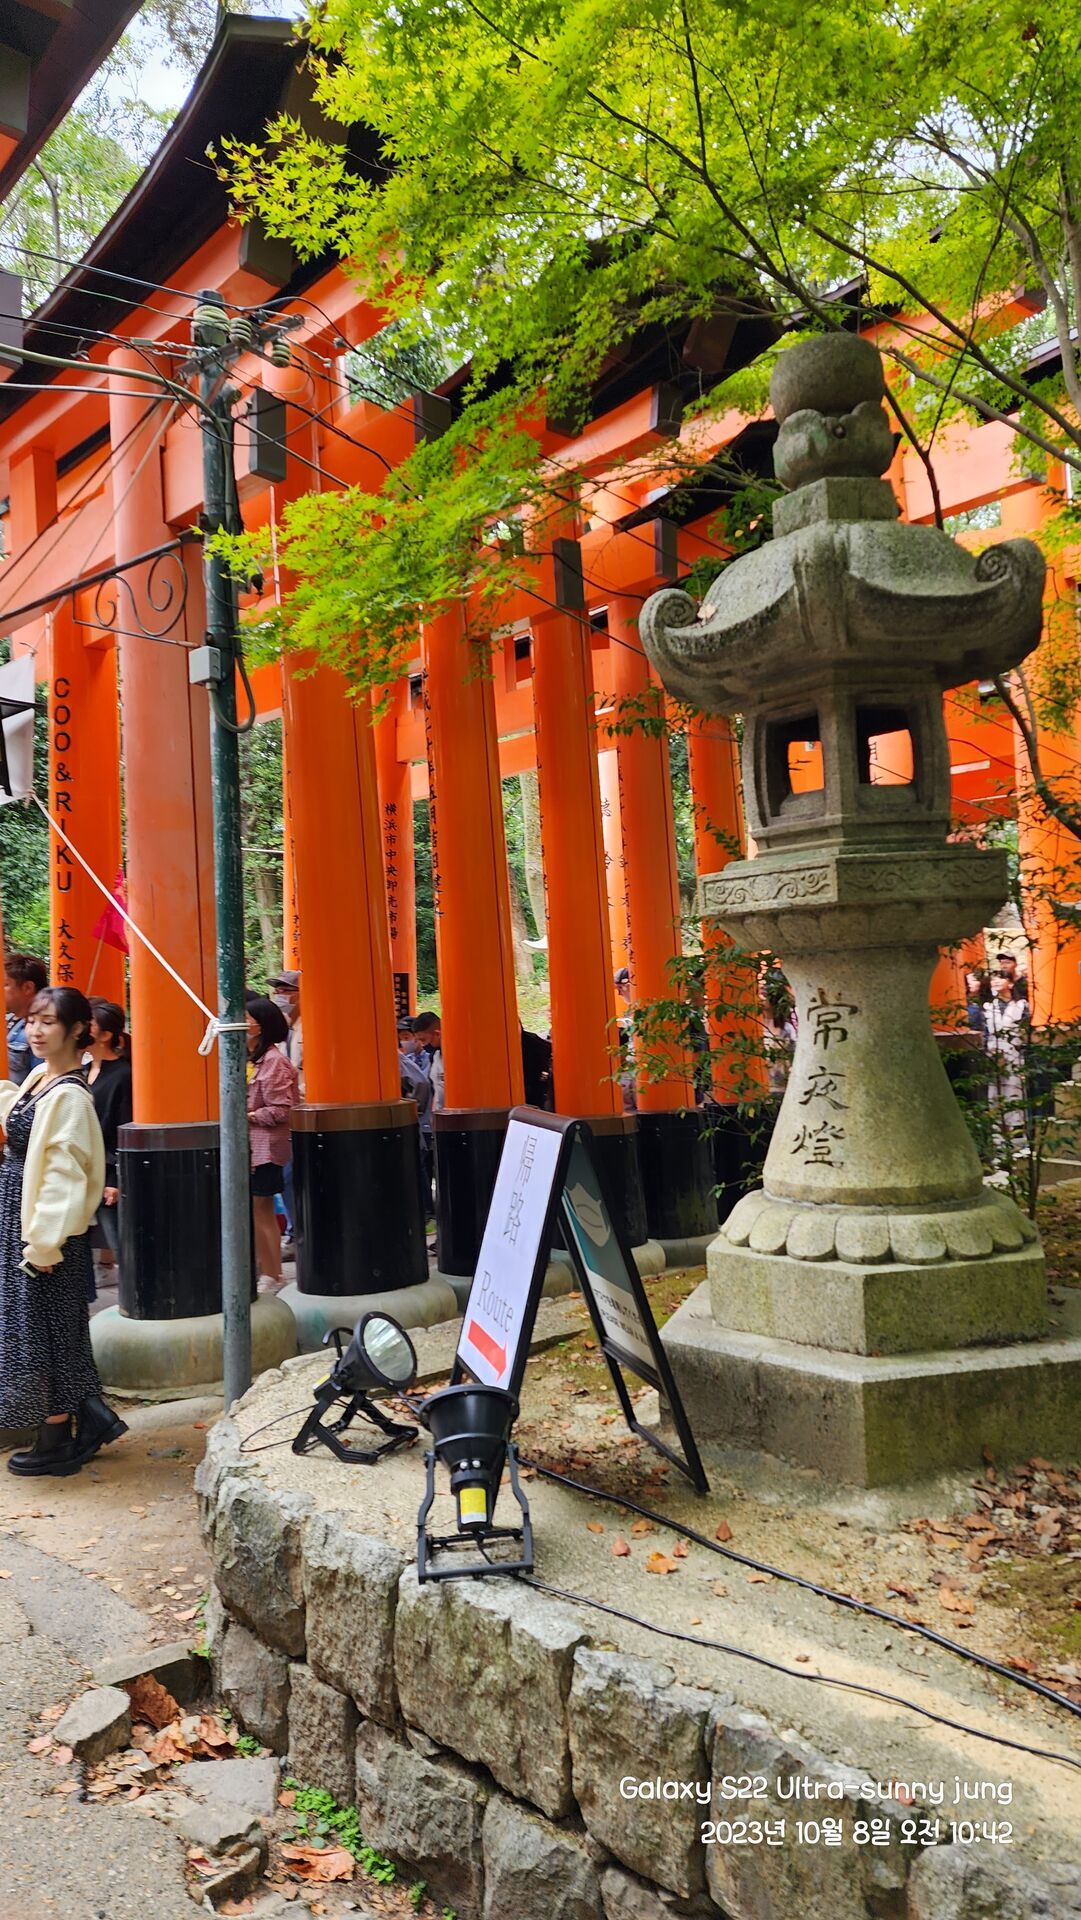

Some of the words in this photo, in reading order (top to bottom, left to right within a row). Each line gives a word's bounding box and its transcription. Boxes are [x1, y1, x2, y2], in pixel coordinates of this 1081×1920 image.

[57, 918, 76, 982] 大久保
[790, 987, 860, 1169] 常夜燈
[477, 1270, 514, 1333] Route
